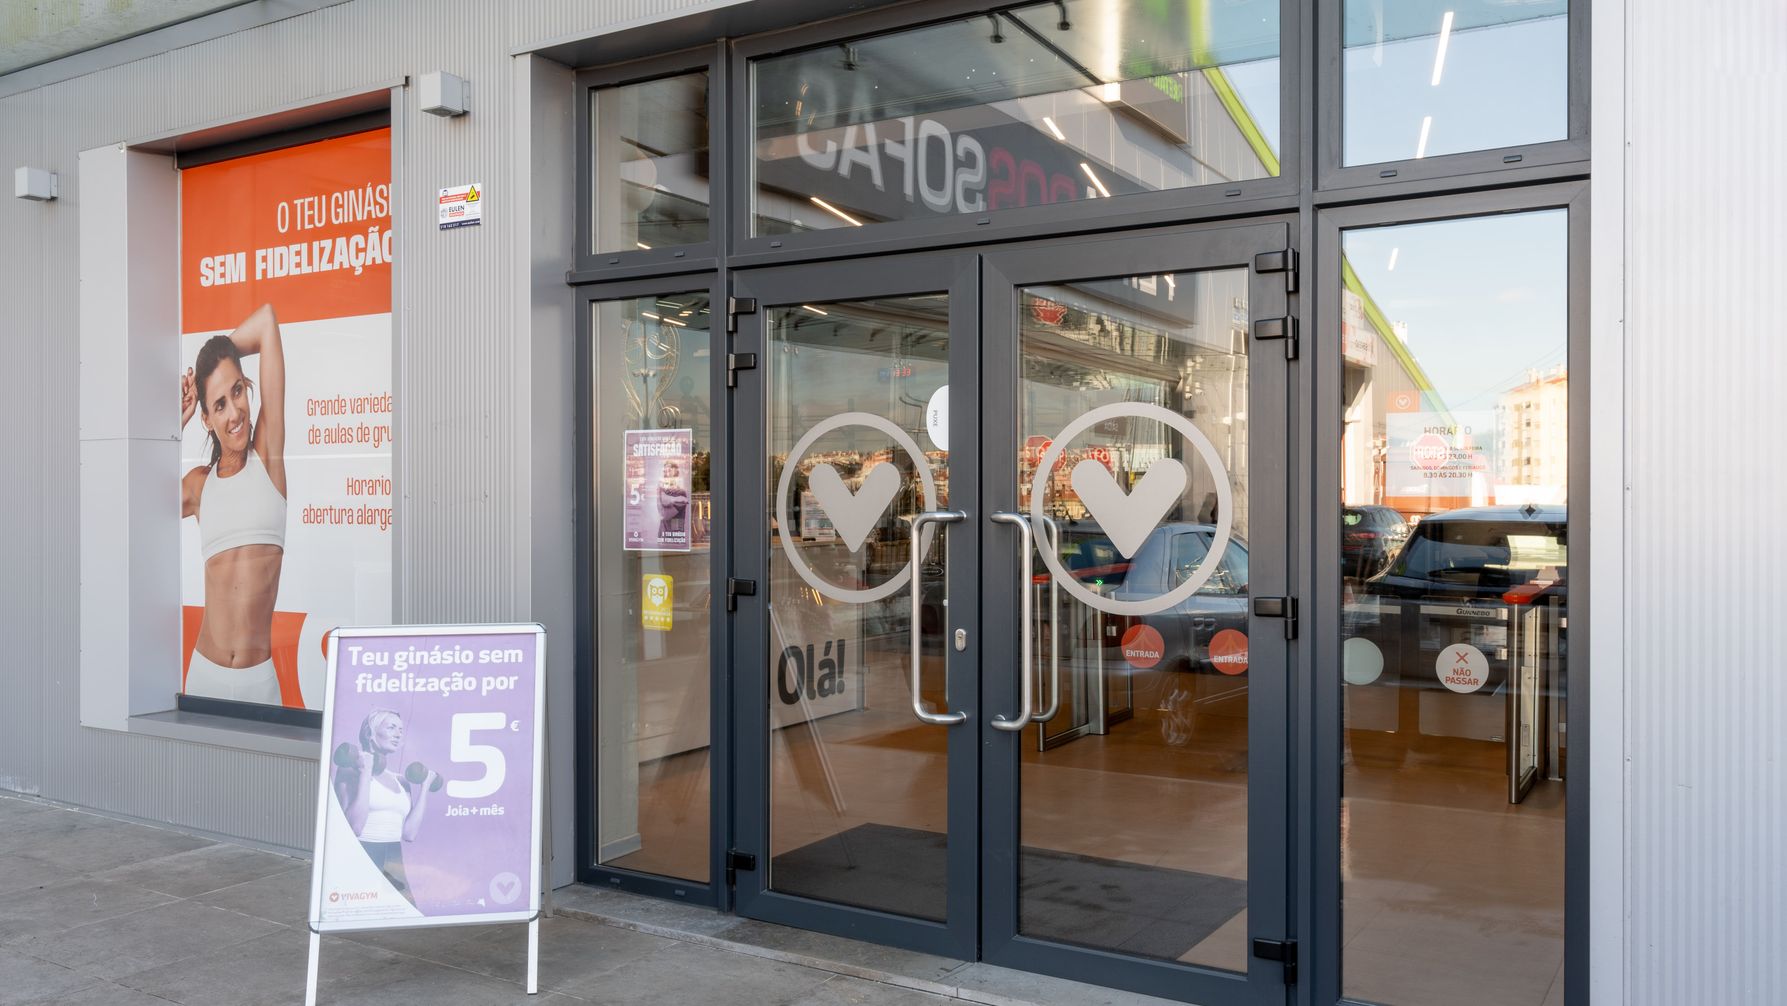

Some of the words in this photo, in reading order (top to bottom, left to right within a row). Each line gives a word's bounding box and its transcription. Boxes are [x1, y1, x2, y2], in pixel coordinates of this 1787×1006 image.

[277, 201, 289, 233] O
[294, 195, 326, 230] TEU
[200, 252, 246, 287] SEM
[255, 226, 392, 280] FIDELIZAÇÃO
[307, 394, 347, 416] Grande
[308, 424, 321, 445] de
[324, 423, 354, 444] aulas
[356, 422, 370, 443] de
[1424, 426, 1472, 435] HORAO
[633, 442, 682, 456] SATISFAÇÃO
[346, 475, 392, 496] Horario
[303, 503, 354, 525] abertura
[348, 646, 389, 666] Teu
[393, 645, 474, 671] ginásio
[478, 648, 523, 664] sem
[1125, 649, 1160, 658] ENTRADA
[1213, 655, 1248, 664] ENTRADA
[777, 638, 846, 705] Olá!
[1445, 676, 1480, 686] PASSAR
[1453, 667, 1472, 677] NÃO
[355, 672, 477, 697] fidelização
[481, 675, 519, 696] por
[446, 712, 507, 799] 5
[510, 720, 520, 732] €
